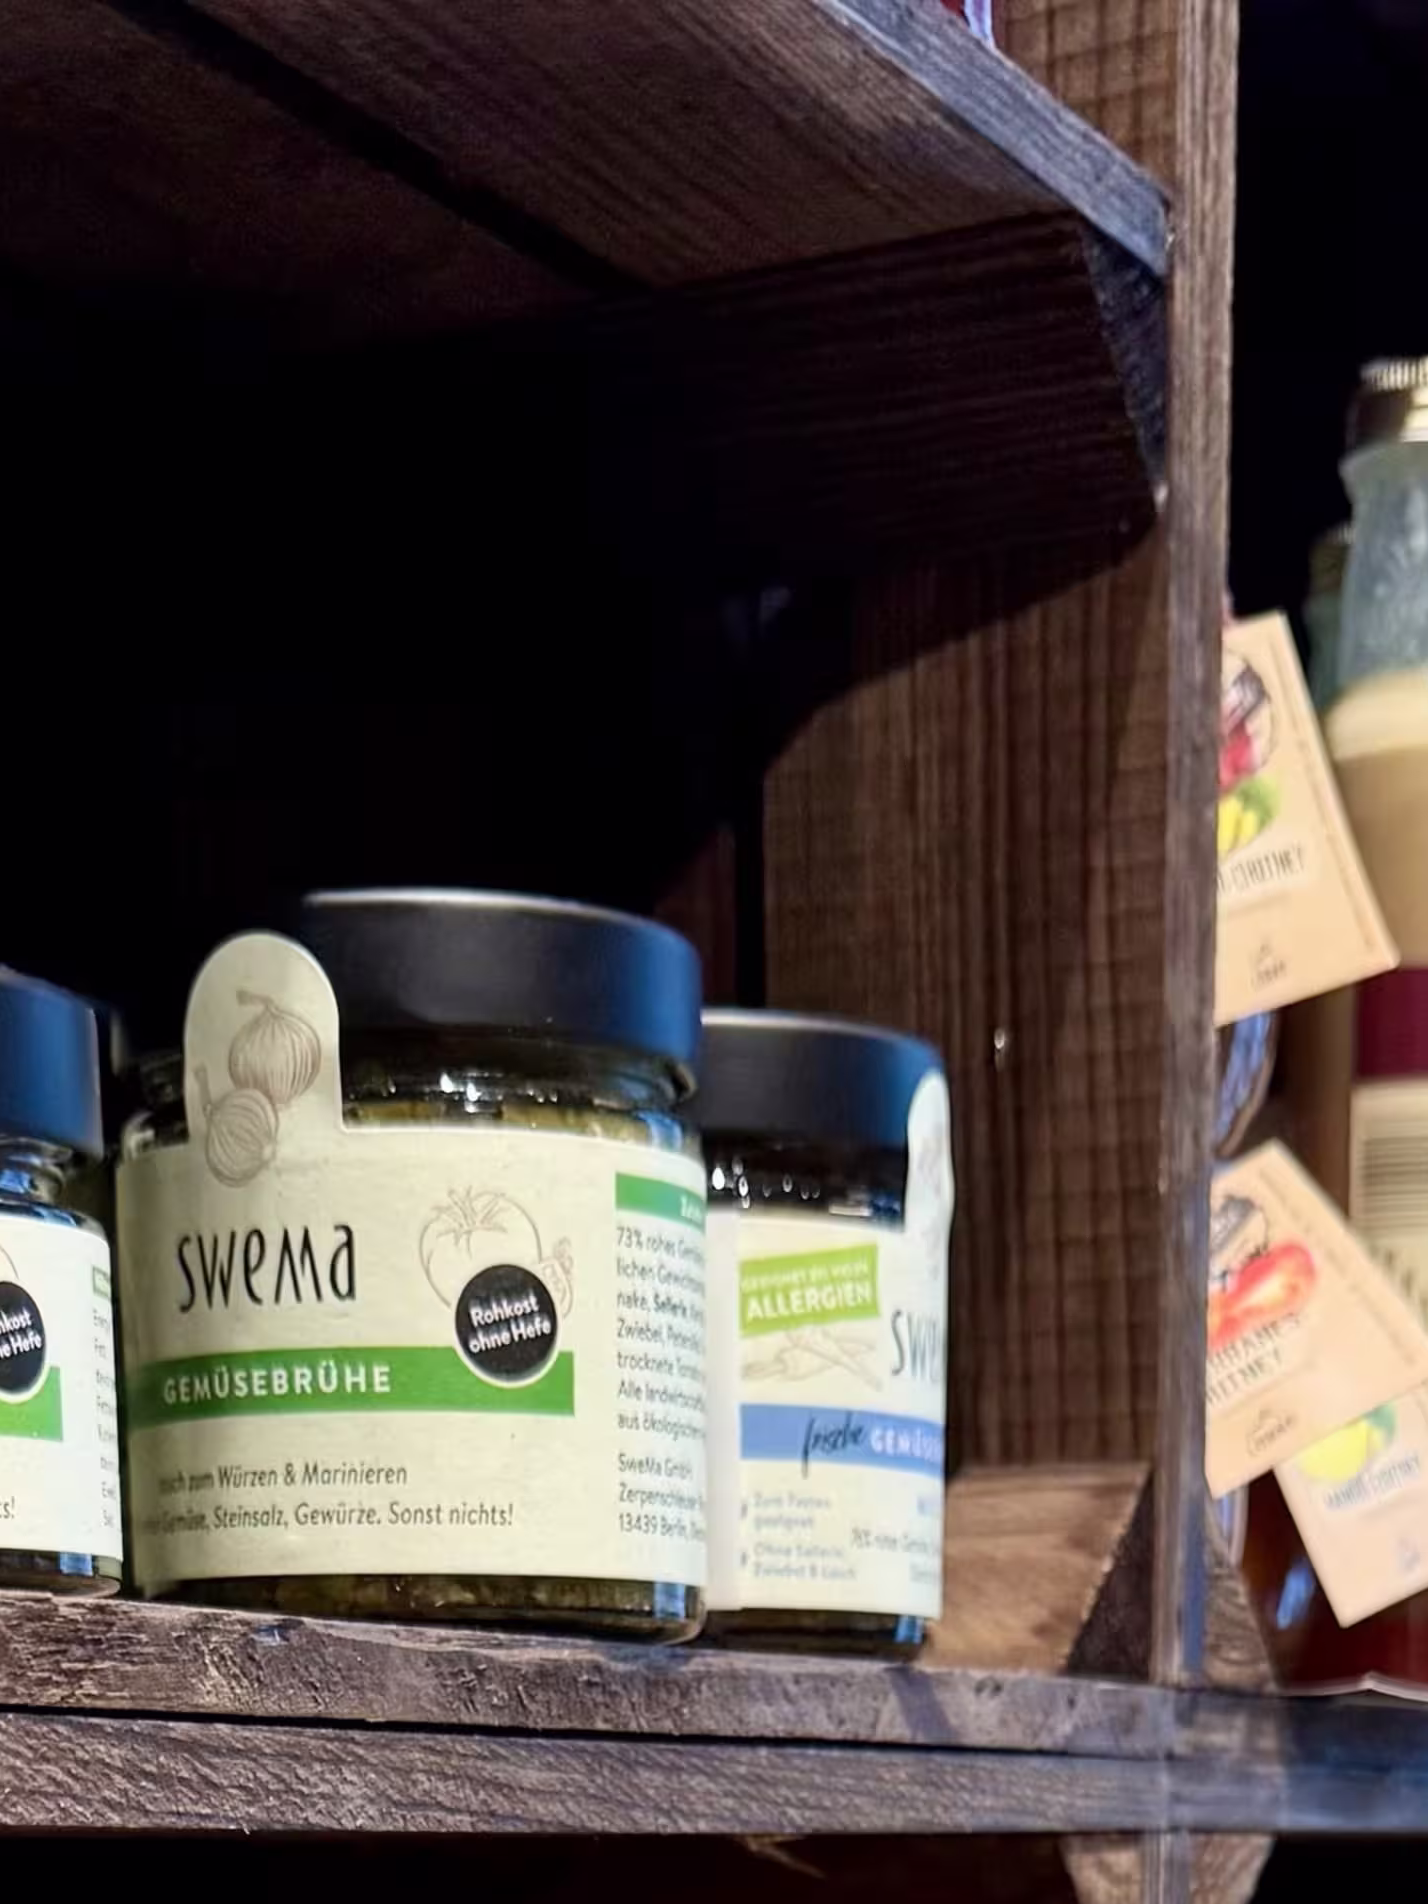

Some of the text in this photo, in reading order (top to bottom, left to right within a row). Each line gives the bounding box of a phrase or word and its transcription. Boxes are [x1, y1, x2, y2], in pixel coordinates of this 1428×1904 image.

[469, 1292, 540, 1328] Rohkost
[746, 1282, 871, 1321] ALLERGIEN
[12, 1331, 43, 1357] Hefe
[468, 1317, 552, 1354] ohne Hefe
[164, 1359, 392, 1405] GEMÜSEBRÜHE
[217, 1465, 278, 1489] Würzen
[283, 1462, 297, 1486] &
[302, 1461, 408, 1486] Marinieren
[212, 1504, 290, 1530] Steinsalz,
[294, 1500, 382, 1527] Gewürze.
[388, 1501, 443, 1526] Sonst
[448, 1502, 514, 1527] nichts!
[618, 1512, 658, 1535] 13439
